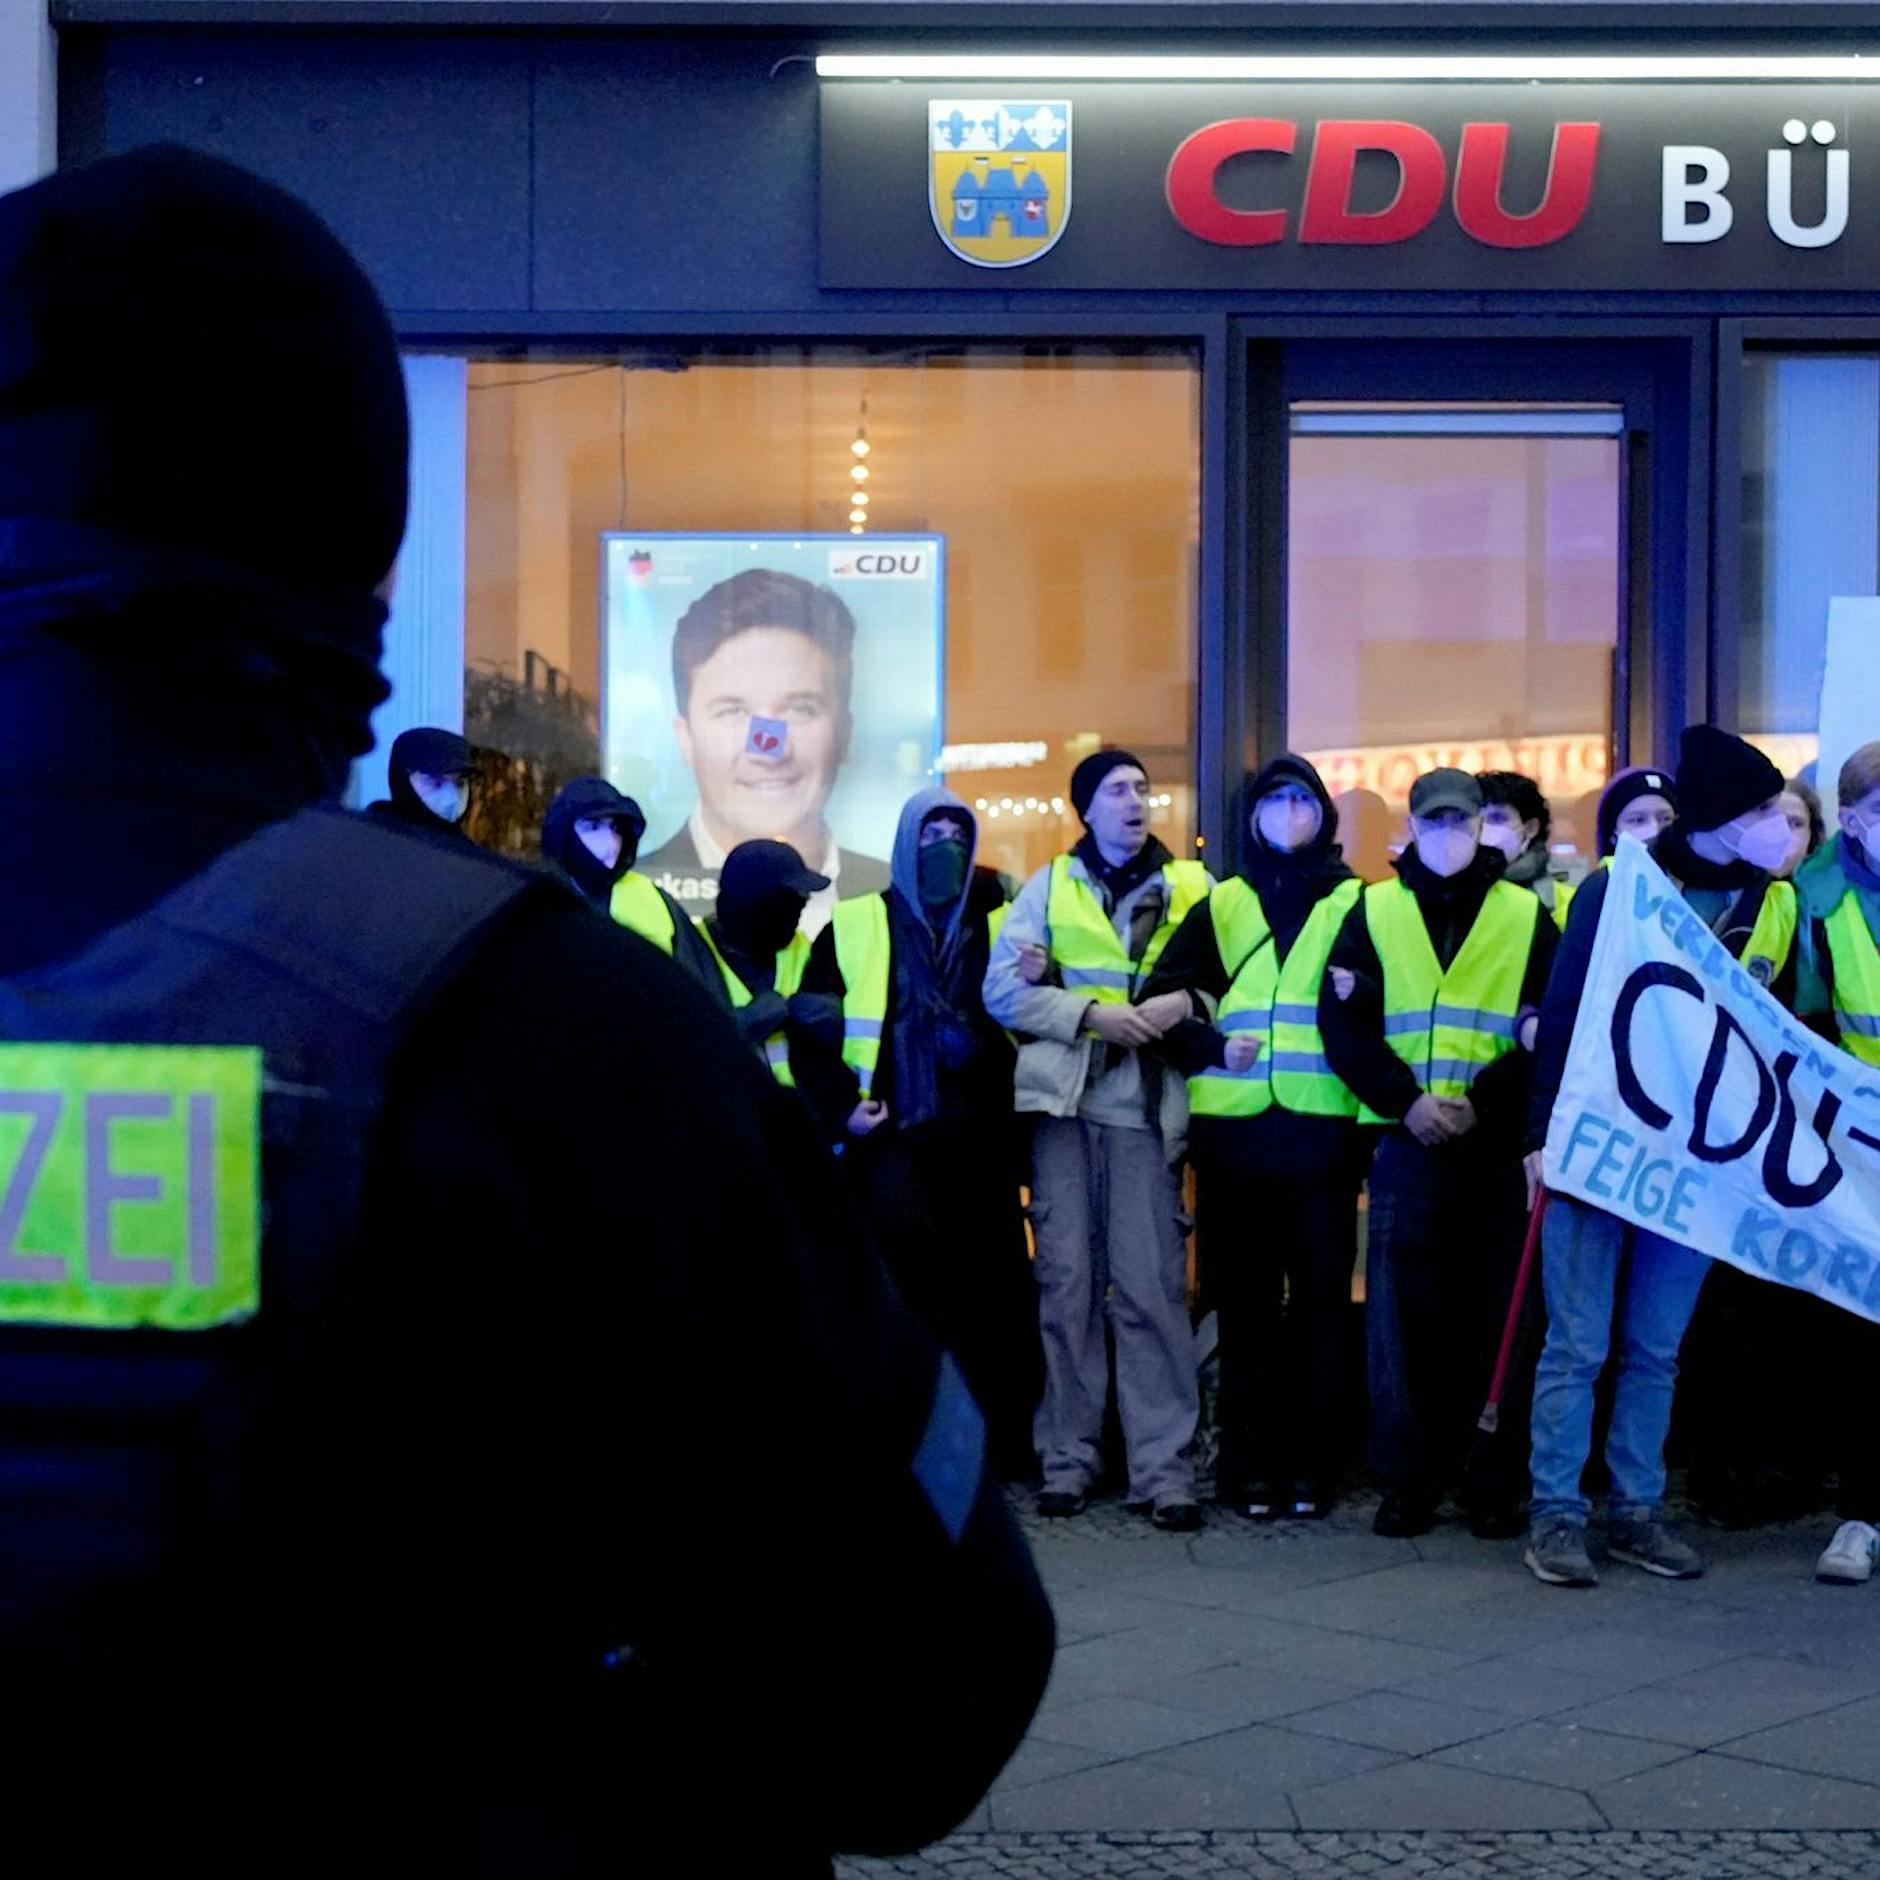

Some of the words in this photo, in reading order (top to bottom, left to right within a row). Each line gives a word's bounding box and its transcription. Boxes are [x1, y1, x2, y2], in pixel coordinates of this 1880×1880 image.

[1166, 118, 1600, 249] CDU
[1661, 119, 1850, 248] BÜ
[856, 555, 920, 574] CDU
[653, 872, 719, 900] kas
[0, 1092, 214, 1287] ZEI
[1559, 1112, 1709, 1234] FEIGE
